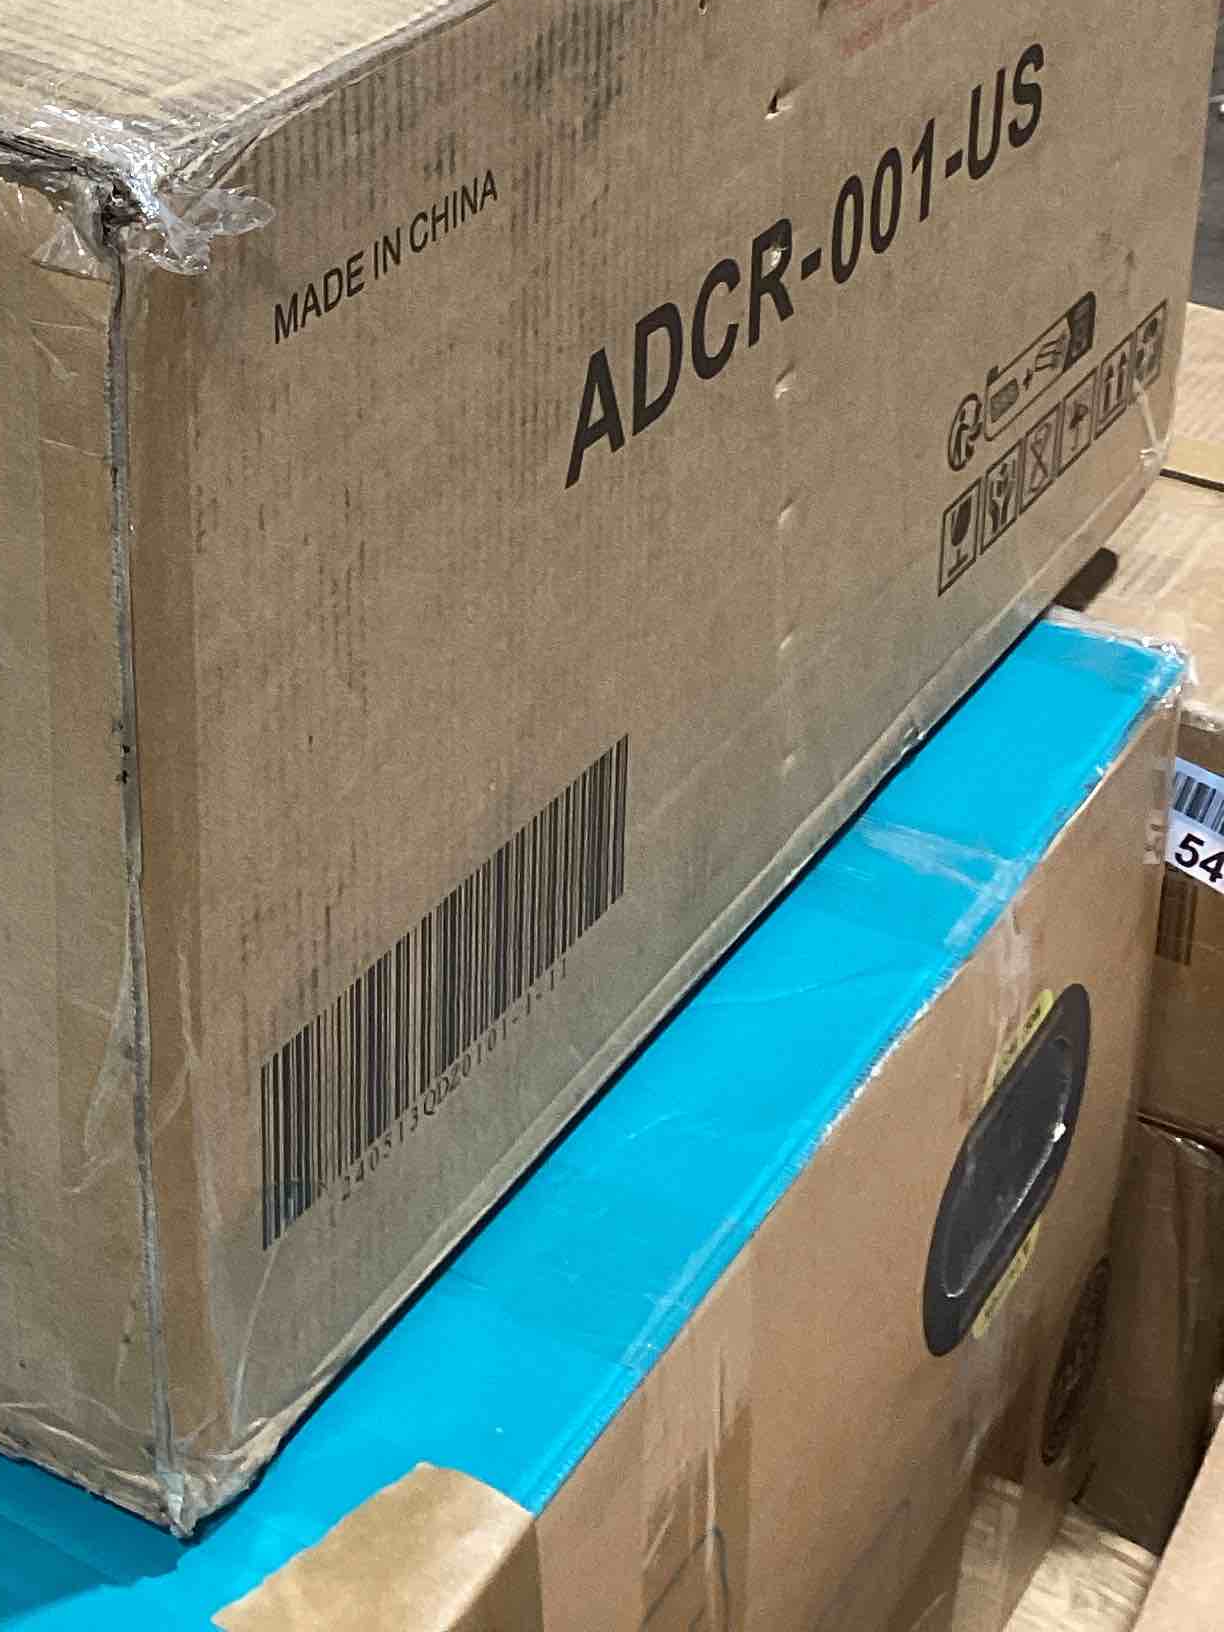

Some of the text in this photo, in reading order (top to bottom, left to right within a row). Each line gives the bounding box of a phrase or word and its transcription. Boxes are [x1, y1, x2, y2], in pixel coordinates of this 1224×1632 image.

[273, 167, 500, 346] MADE IN CHINA
[564, 42, 1046, 490] ADCR-001-US
